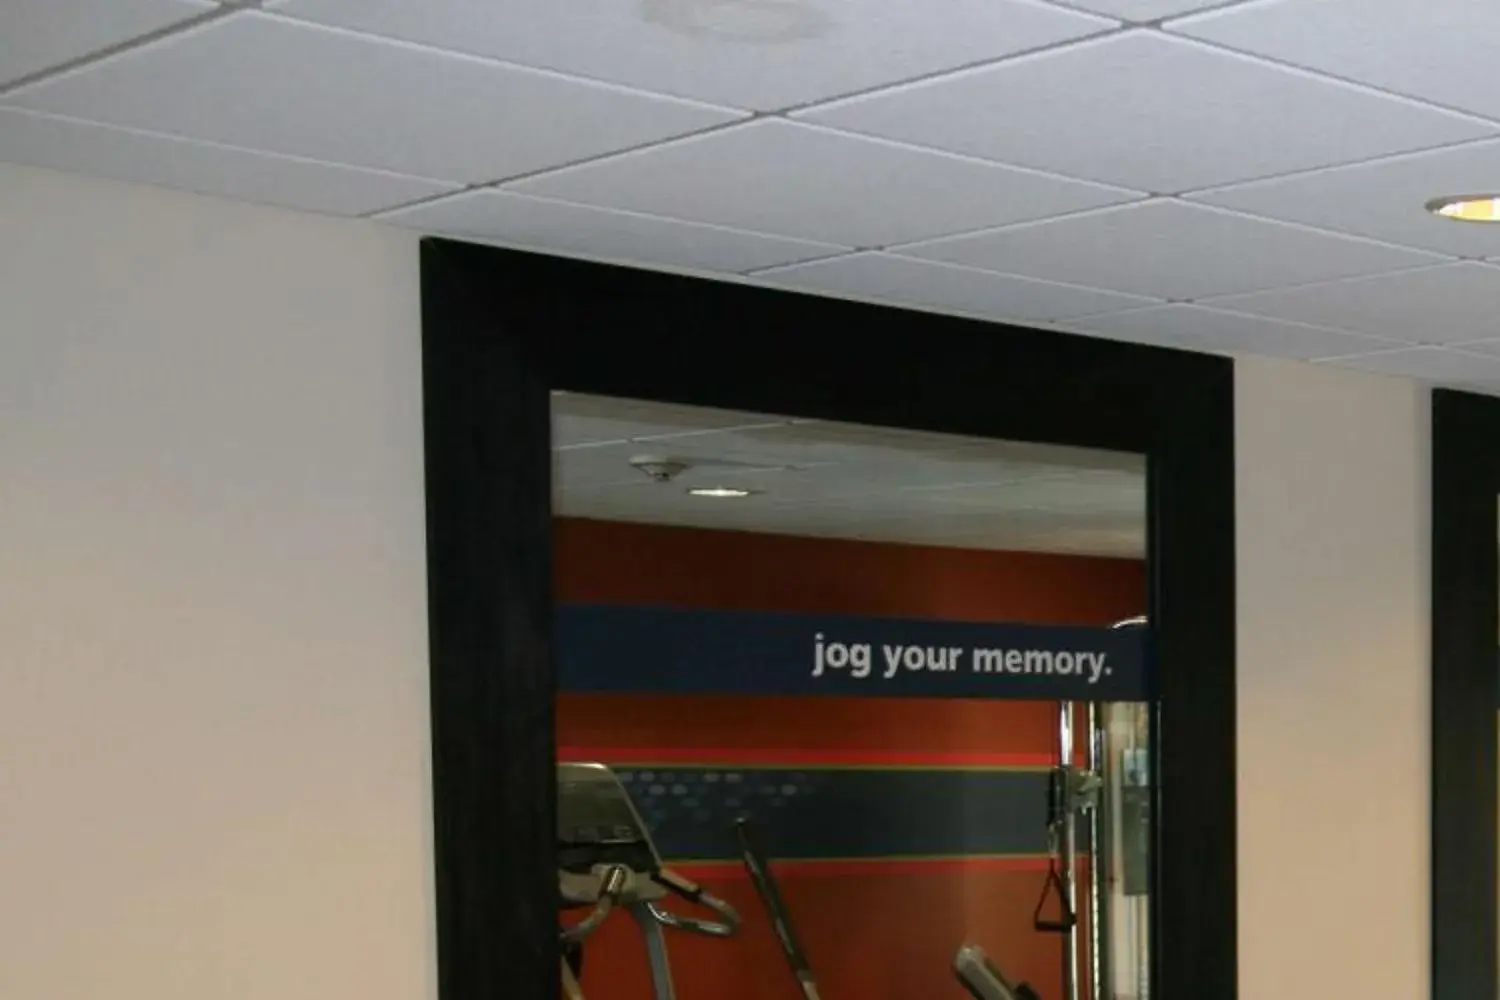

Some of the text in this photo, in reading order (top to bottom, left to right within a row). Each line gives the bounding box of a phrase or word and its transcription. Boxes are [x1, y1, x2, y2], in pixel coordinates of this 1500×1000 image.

[811, 633, 1113, 684] jog your memory.
